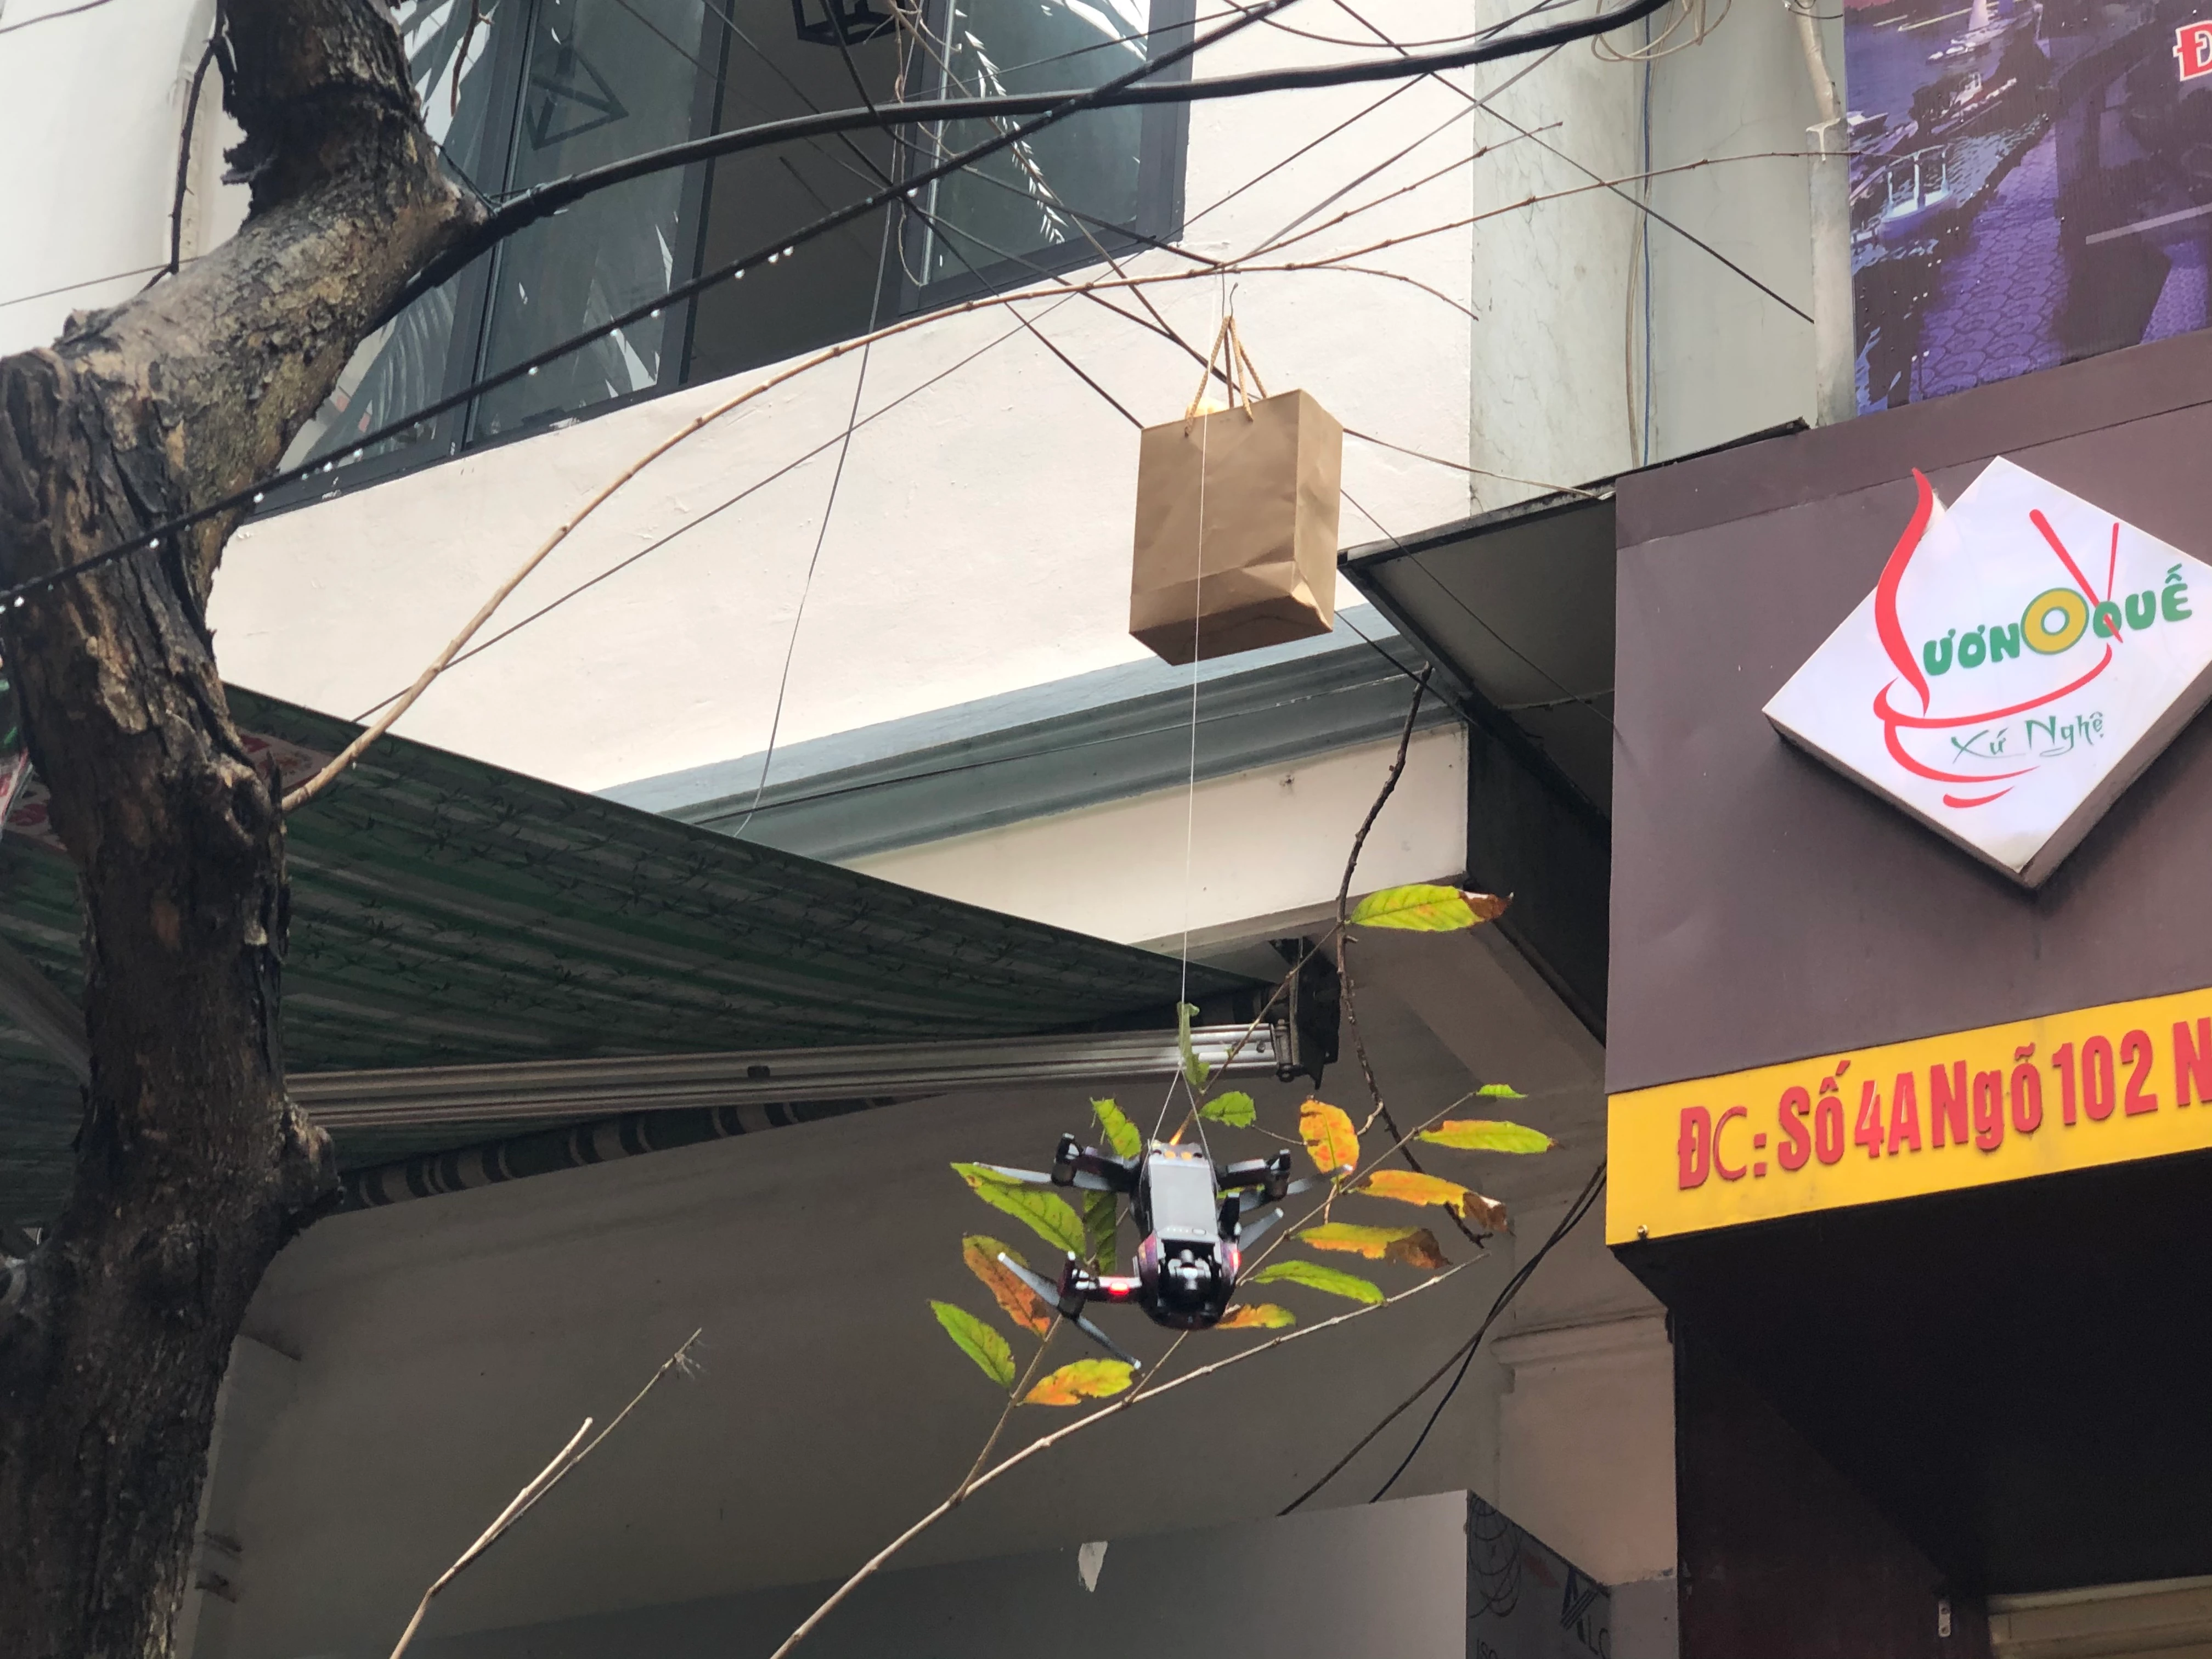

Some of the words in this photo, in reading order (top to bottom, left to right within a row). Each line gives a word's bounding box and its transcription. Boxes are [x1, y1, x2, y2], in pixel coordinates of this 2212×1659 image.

[1951, 727, 2025, 764] Xứ
[2024, 712, 2104, 757] Nghệ
[1678, 1105, 1767, 1190] ĐC:
[1778, 1060, 1851, 1171] Số
[1854, 1072, 1921, 1158] 4A
[1930, 1043, 2042, 1152] Ngõ
[2052, 1028, 2158, 1125] 102
